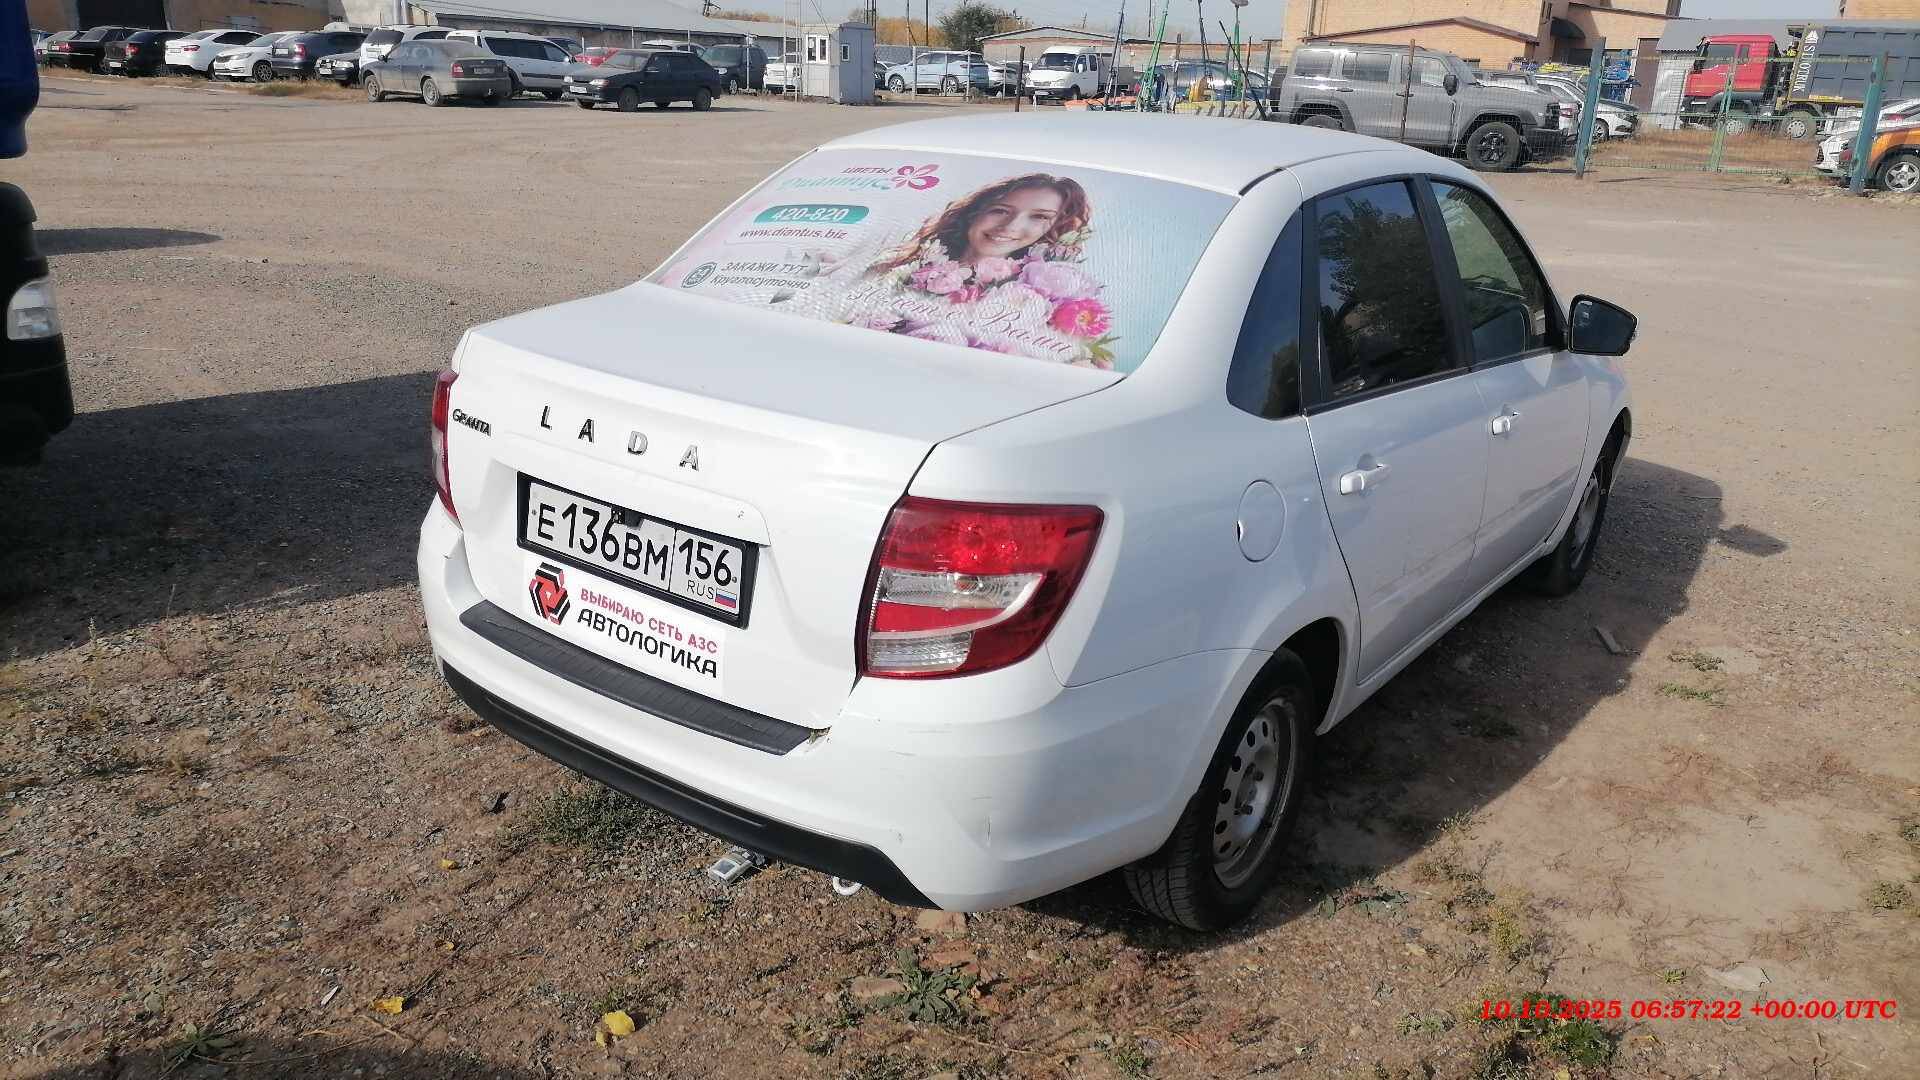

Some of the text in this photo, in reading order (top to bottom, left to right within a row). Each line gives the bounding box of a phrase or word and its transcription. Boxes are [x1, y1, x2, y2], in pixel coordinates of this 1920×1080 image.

[770, 207, 850, 221] 420-820
[740, 227, 848, 240] www.diantus.biz
[720, 261, 809, 274] ЗАКАЖИ ТУТ
[540, 405, 701, 472] LADA
[679, 537, 734, 587] 156
[687, 579, 715, 600] RUS
[580, 587, 718, 655] ВЫБИРАЮ СЕТЬ АЗС
[577, 607, 718, 679] АВТОЛОГИКА
